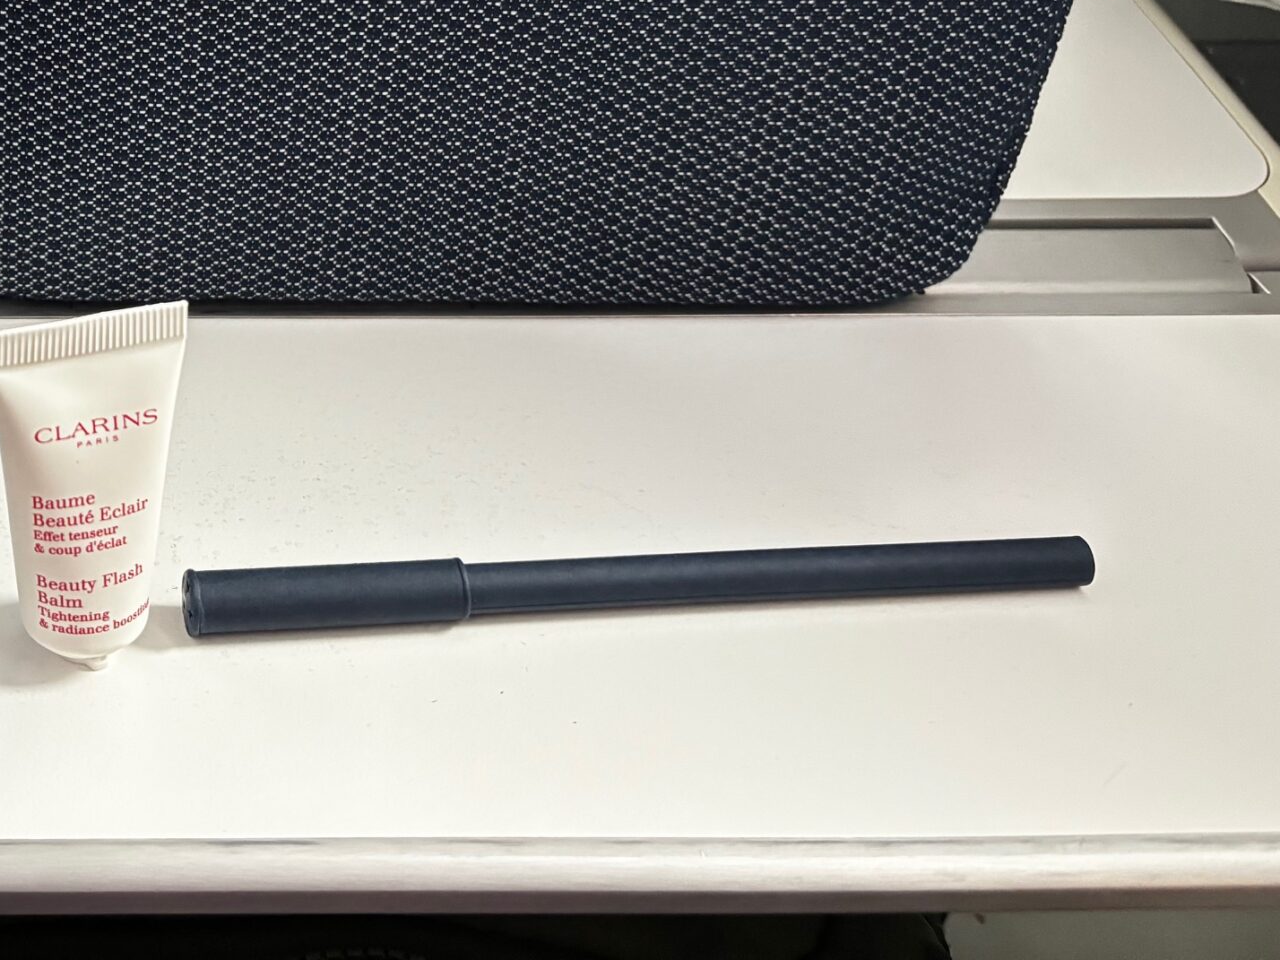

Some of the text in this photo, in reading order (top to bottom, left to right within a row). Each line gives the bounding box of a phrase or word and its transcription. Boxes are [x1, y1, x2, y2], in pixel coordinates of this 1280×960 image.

[34, 408, 158, 444] CLARINS
[76, 435, 120, 448] PARIS
[32, 494, 96, 510] Baume
[32, 498, 148, 528] Beauté Eclair
[33, 525, 119, 542] Effet tenseur
[34, 536, 127, 557] & coup d'éclat
[36, 563, 143, 594] Beauty Flash
[37, 590, 83, 609] Balm
[37, 604, 110, 623] Tightening
[39, 618, 49, 629] &
[51, 624, 110, 636] radiance
